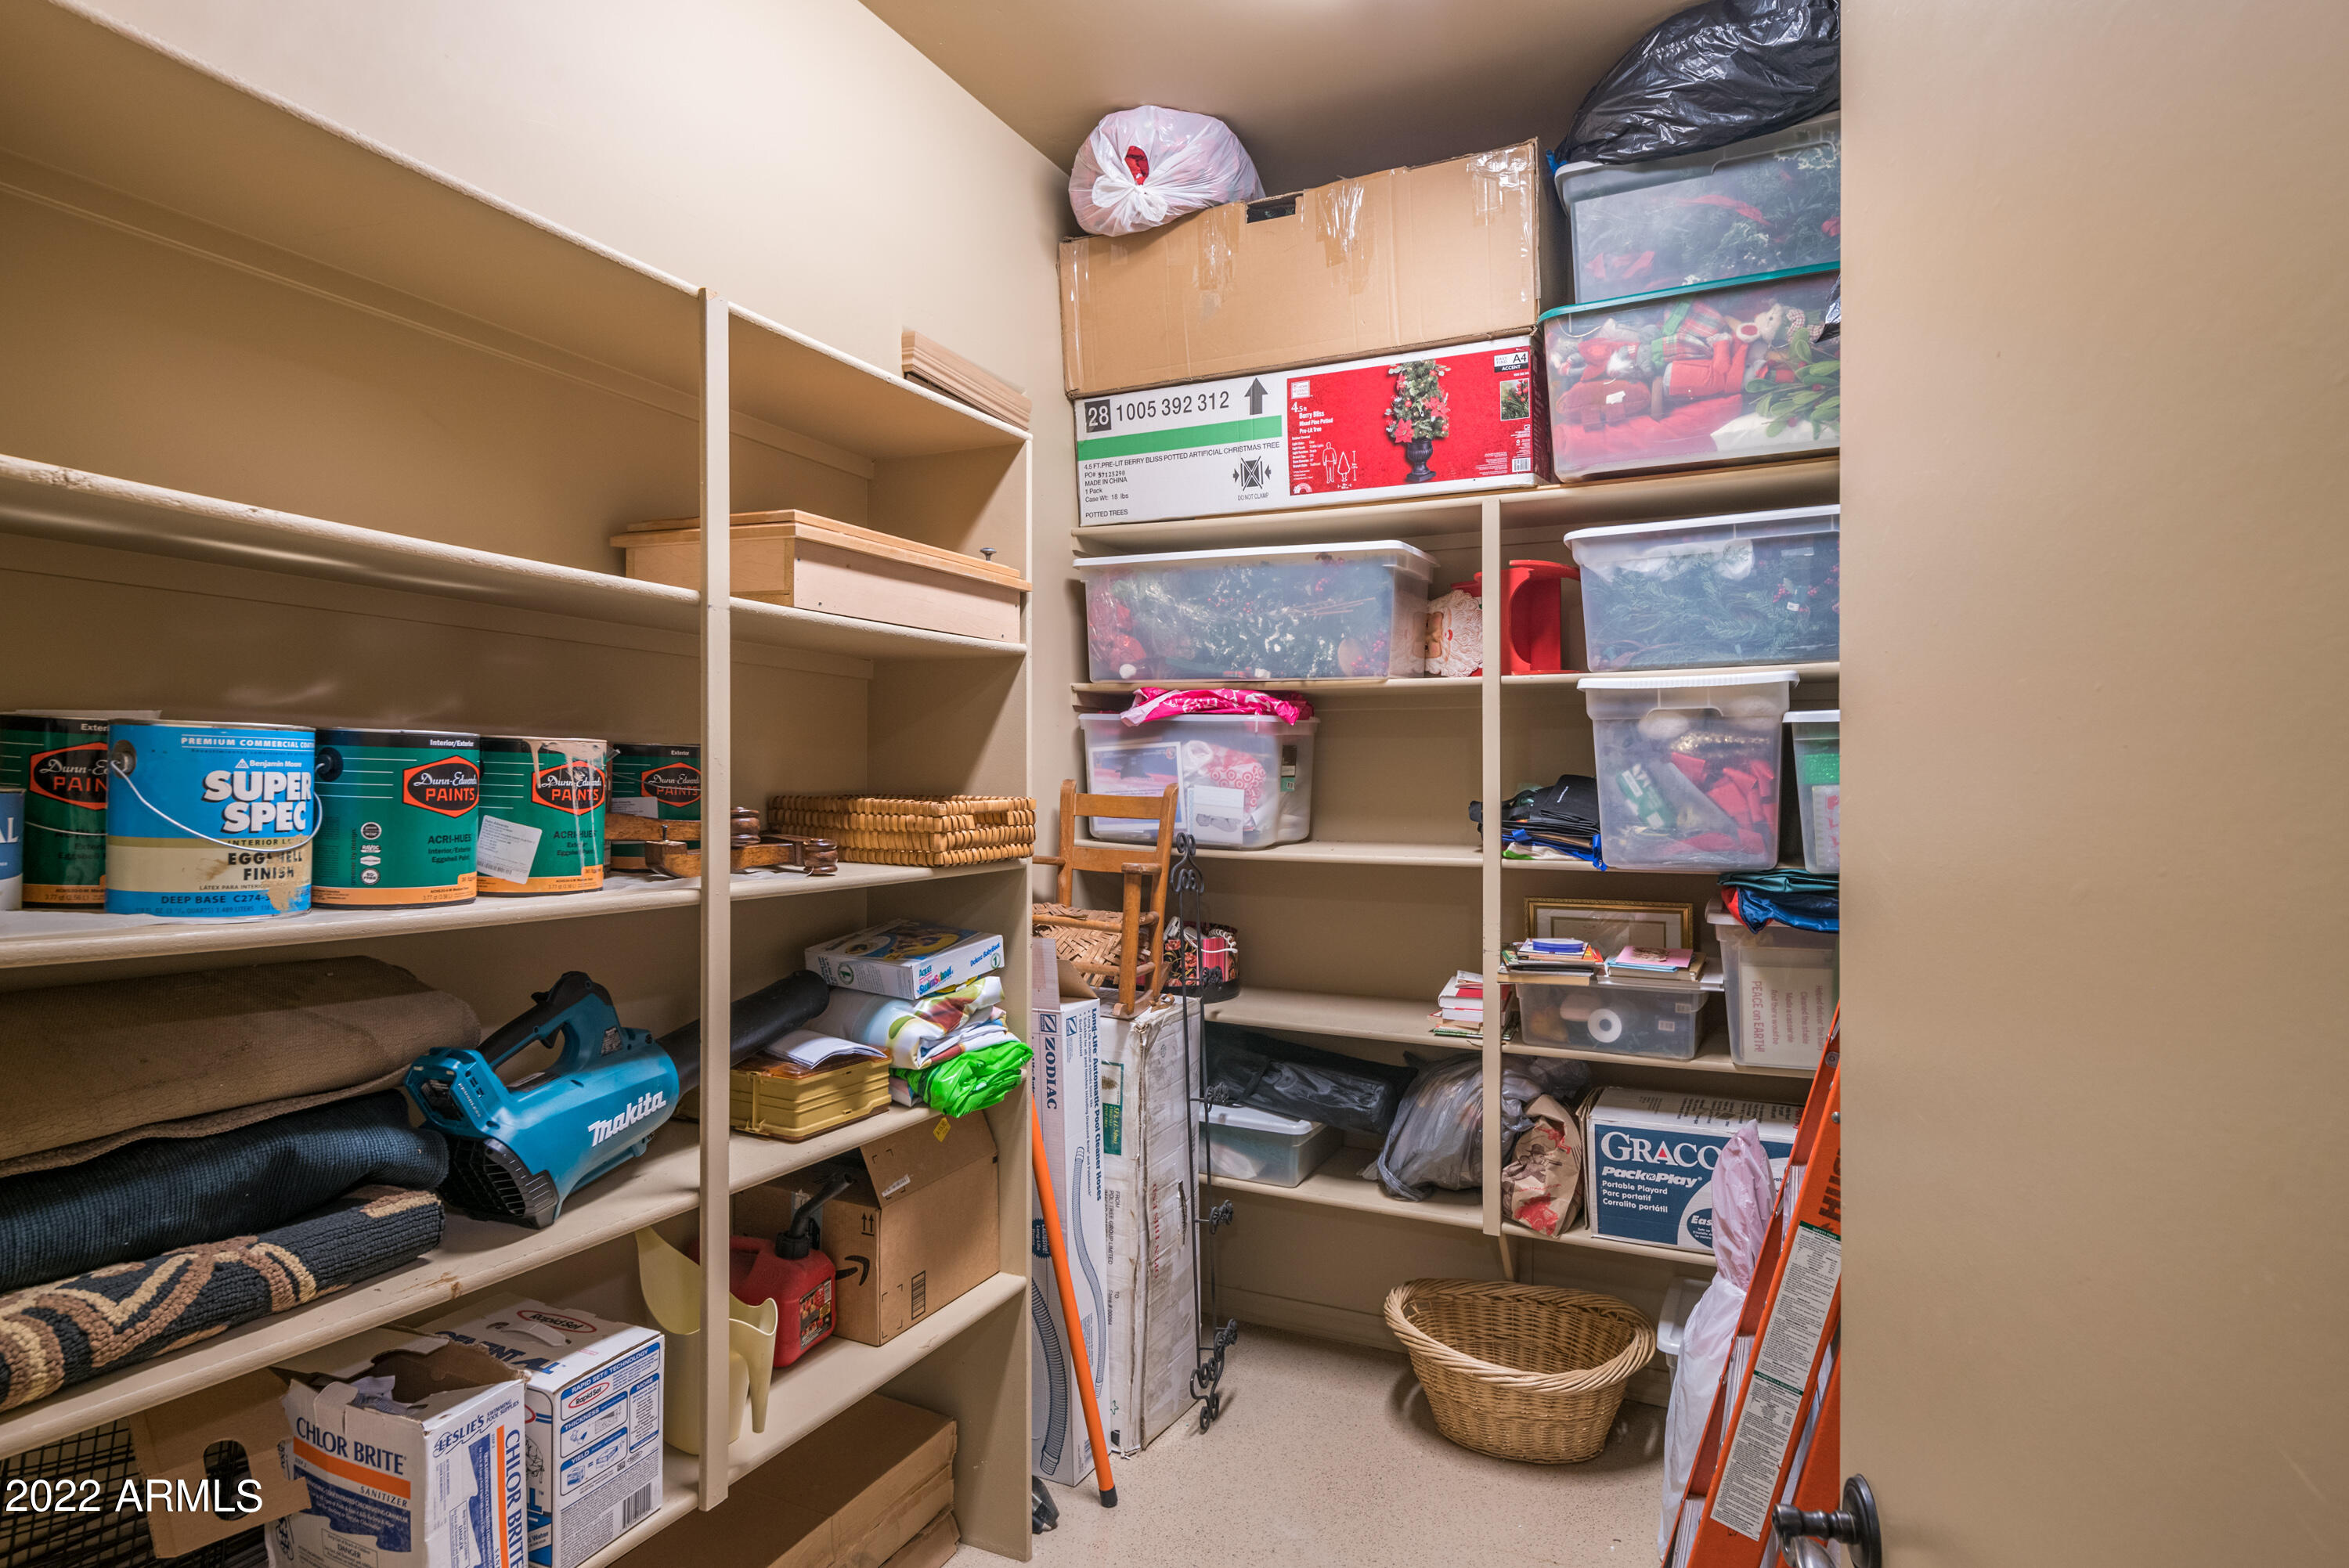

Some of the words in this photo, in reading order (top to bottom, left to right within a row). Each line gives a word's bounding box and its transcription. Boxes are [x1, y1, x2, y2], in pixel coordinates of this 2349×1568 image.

[1513, 353, 1527, 363] A4
[1088, 406, 1109, 427] 28
[1116, 400, 1156, 422] 1005
[1161, 395, 1193, 416] 392
[1197, 391, 1229, 411] 312
[1291, 401, 1303, 413] 4.5
[1164, 452, 1188, 461] POTTED
[1189, 448, 1222, 458] ARTIFICIAL
[1223, 444, 1261, 454] CHRISTMAS
[181, 737, 236, 746] PREMIUM
[240, 739, 299, 748] COMMERCIAL
[249, 759, 284, 768] Benjamin
[200, 770, 312, 802] SUPER
[413, 771, 478, 787] Dunn-Edwards
[648, 773, 700, 784] Dunn-Edwards
[425, 788, 475, 802] PAINTS
[656, 785, 698, 796] PAINTS
[220, 801, 307, 833] SPEC
[428, 834, 471, 845] ACRI-HUES
[244, 865, 294, 881] FINISH
[161, 896, 193, 904] DEEP
[195, 895, 227, 904] BASE
[918, 965, 932, 978] Aqua
[1752, 981, 1763, 1008] PEACE
[1753, 1009, 1762, 1021] on
[1753, 1022, 1765, 1053] EARTH!
[1045, 1036, 1057, 1109] ZODIAC
[1601, 1131, 1721, 1170] GRACO
[1602, 1166, 1646, 1181] Pack
[1655, 1173, 1698, 1188] Play
[1602, 1180, 1636, 1191] Portable
[1637, 1184, 1668, 1195] Playard
[1602, 1189, 1620, 1198] Parc
[1622, 1193, 1652, 1202] portatif
[1603, 1198, 1636, 1209] Corralito
[1639, 1202, 1668, 1213] portátil
[529, 1314, 564, 1326] Rapid
[565, 1320, 583, 1330] Set
[572, 1379, 591, 1393] RAPID
[608, 1349, 648, 1372] TECHNOLOGY
[636, 1377, 653, 1390] MORE
[576, 1391, 593, 1404] Rapid
[593, 1387, 603, 1397] Set
[485, 1413, 500, 1423] POOL
[500, 1400, 519, 1418] SUPPLIES
[486, 1399, 512, 1417] SWIMMING
[565, 1408, 600, 1430] THICKNESS
[438, 1415, 485, 1451] LESLIE'S
[296, 1416, 348, 1458] CHLOR
[353, 1440, 404, 1476] BRITE
[572, 1450, 590, 1464] YIELD
[504, 1429, 521, 1509] CHLOR
[360, 1486, 408, 1508] SANITIZER
[337, 1543, 361, 1559] DANGER
